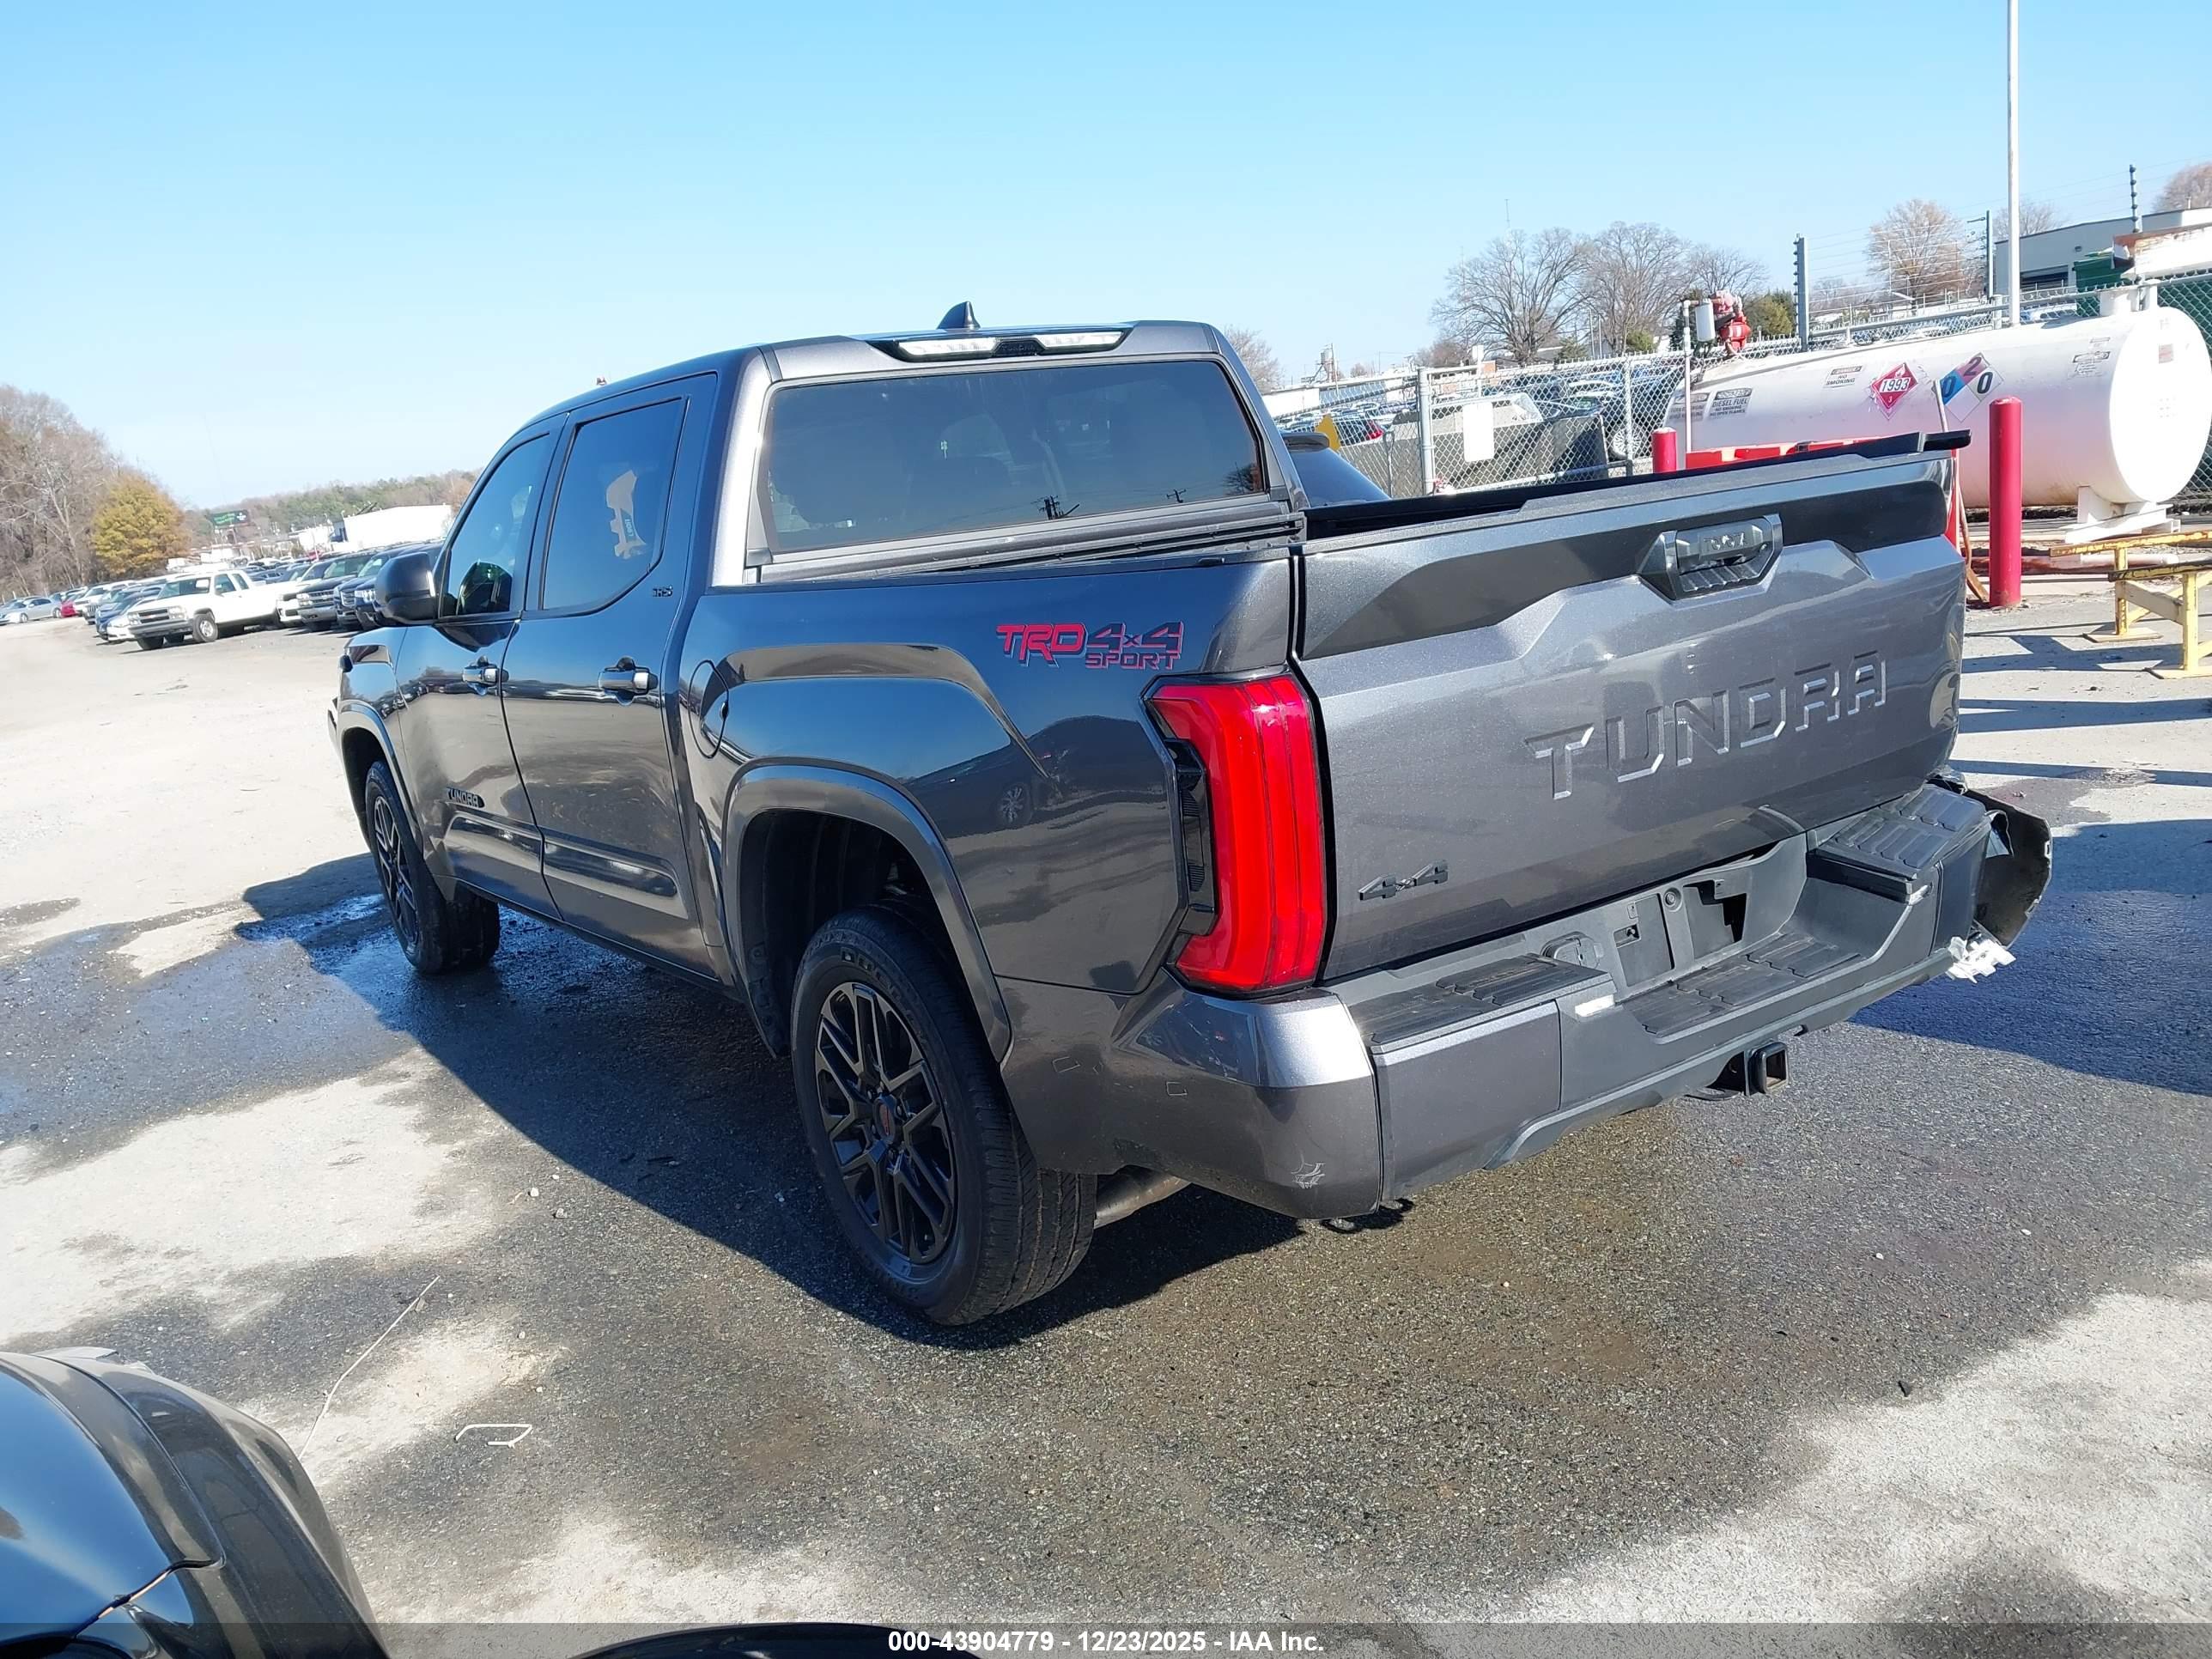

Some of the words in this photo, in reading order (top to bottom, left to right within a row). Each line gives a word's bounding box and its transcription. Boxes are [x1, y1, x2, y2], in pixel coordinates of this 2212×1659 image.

[1963, 356, 1982, 376] 2
[1882, 378, 1910, 392] 1993
[1942, 376, 1956, 398] 0
[1978, 372, 1993, 394] 0
[1712, 399, 1732, 408] DIESEL
[996, 622, 1088, 668] TRD
[1085, 652, 1182, 671] SPORT
[1524, 650, 1887, 799] TUNDRA
[447, 787, 479, 808] TUNDRA
